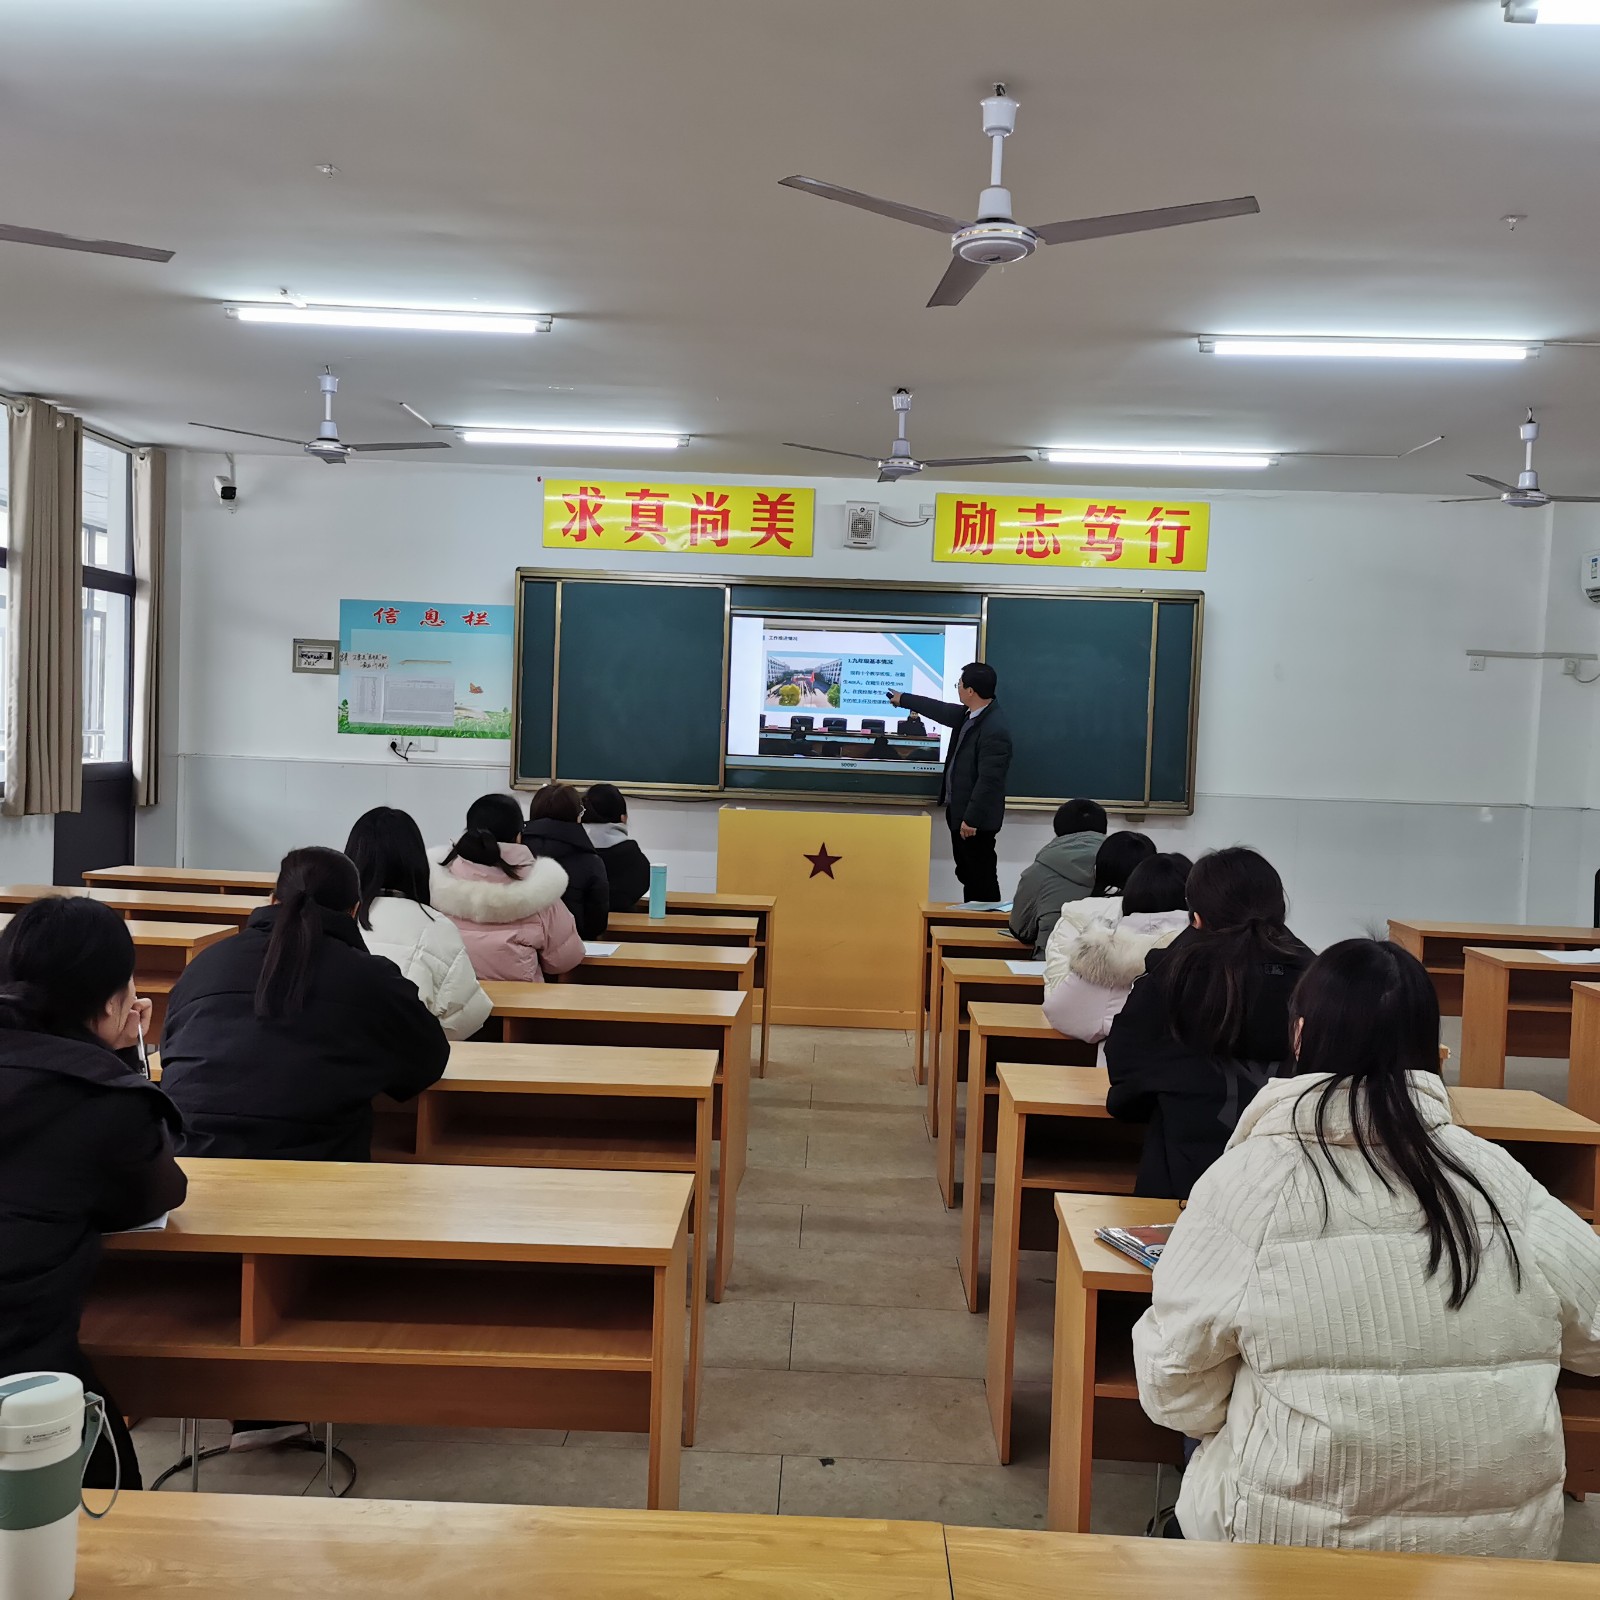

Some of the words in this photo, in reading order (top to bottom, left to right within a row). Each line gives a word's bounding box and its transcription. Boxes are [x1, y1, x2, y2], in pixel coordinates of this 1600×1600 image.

[561, 486, 795, 550] 求真尚美
[951, 500, 1191, 564] 励志笃行
[373, 607, 492, 627] 信息栏
